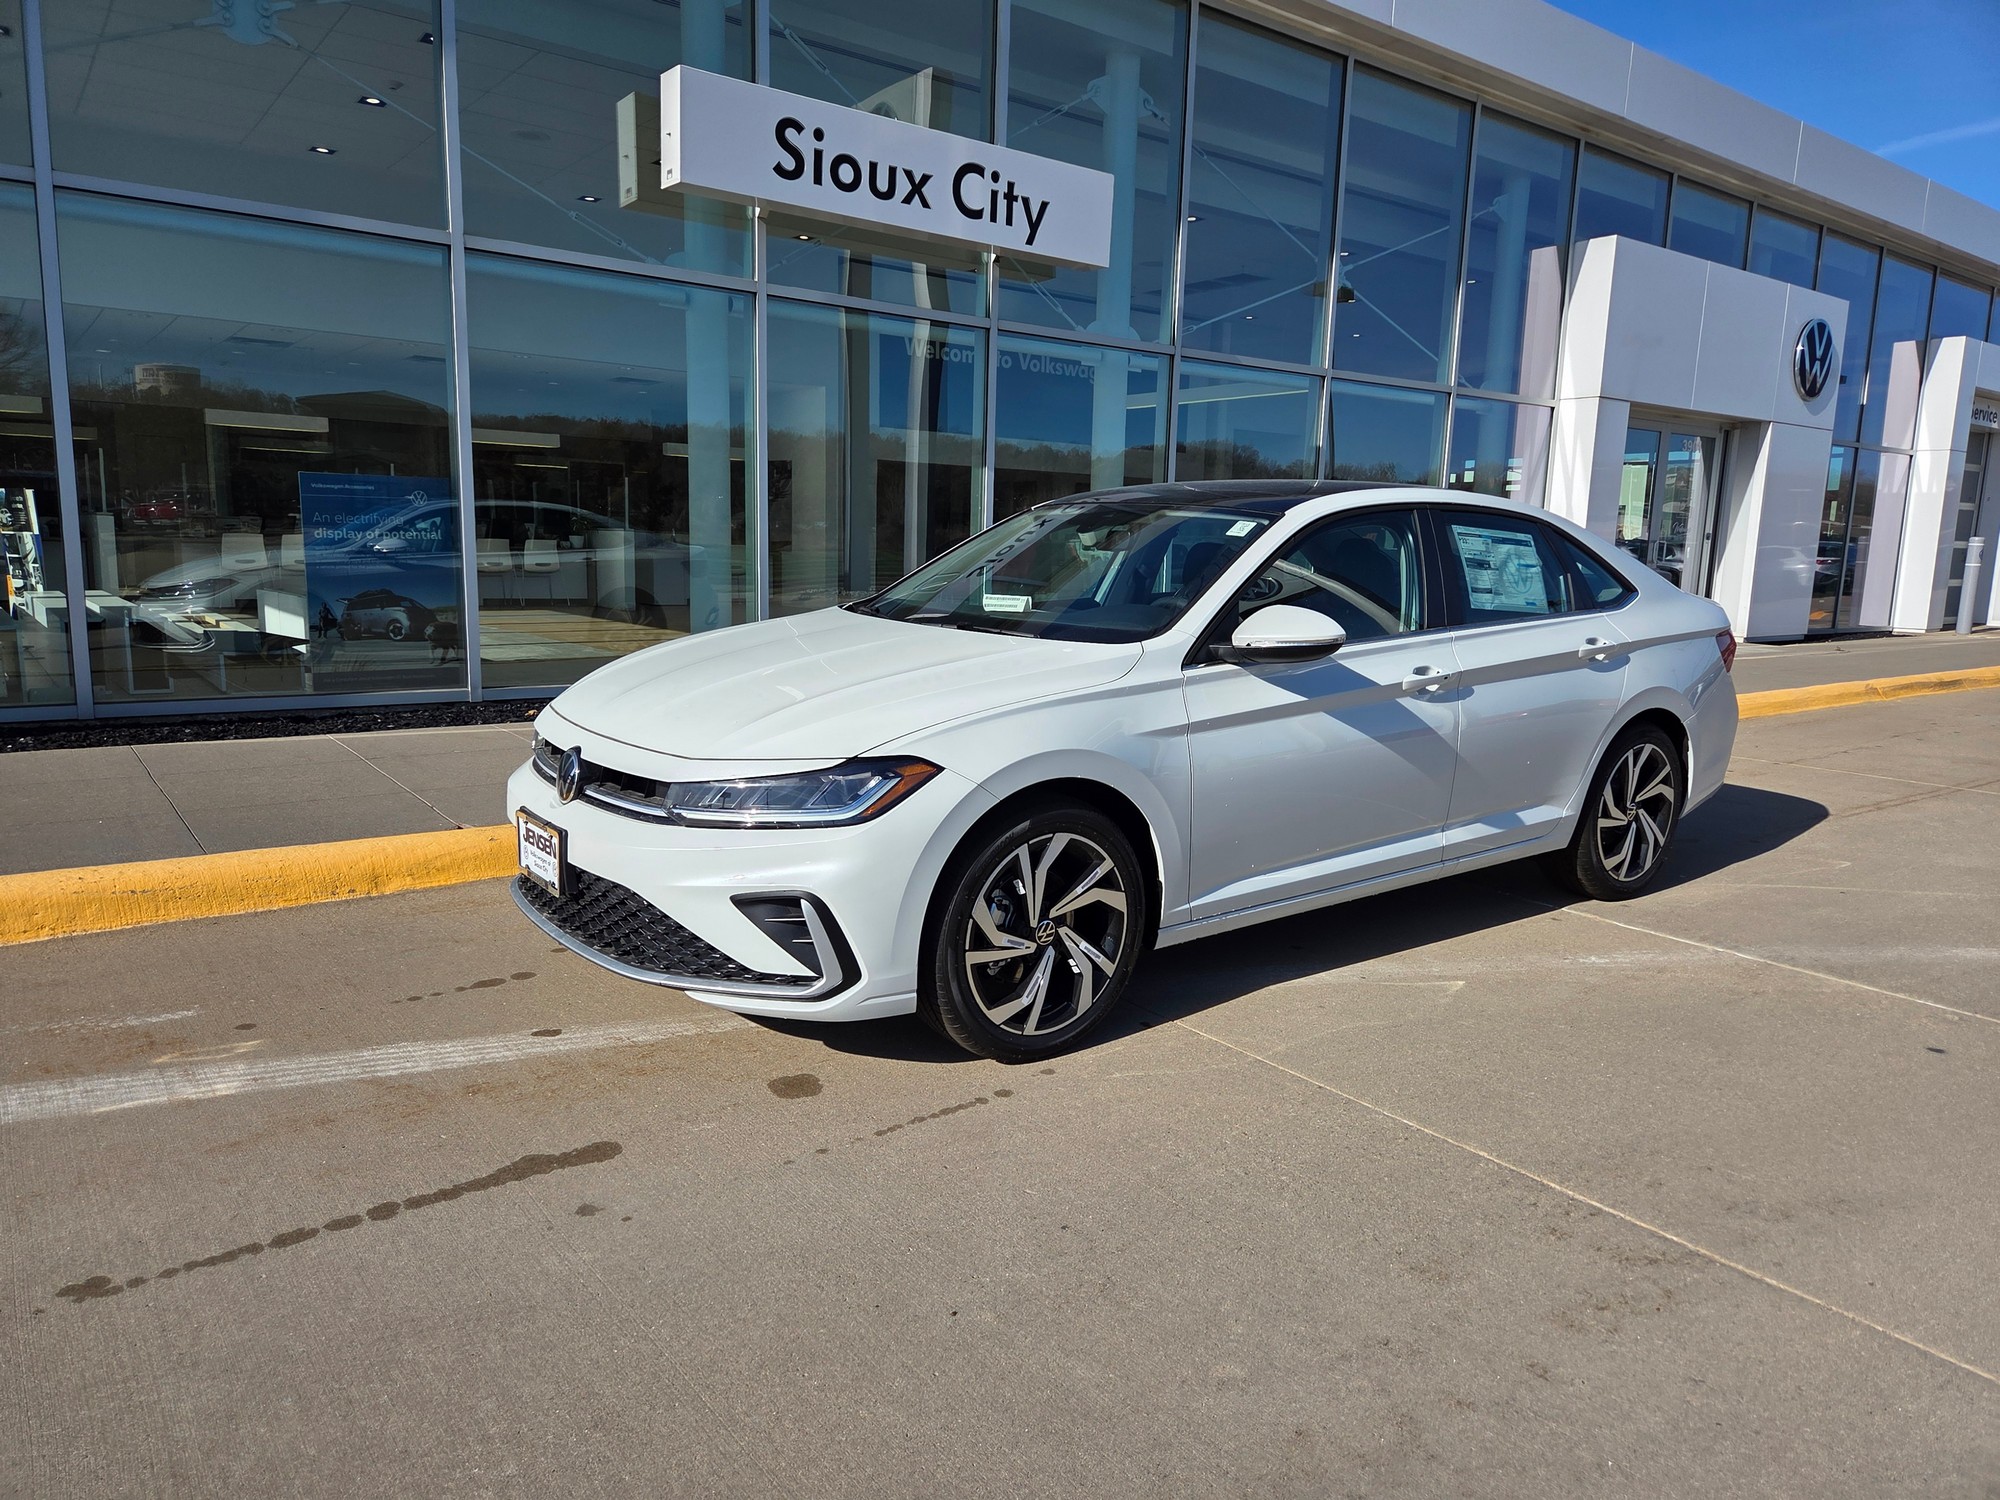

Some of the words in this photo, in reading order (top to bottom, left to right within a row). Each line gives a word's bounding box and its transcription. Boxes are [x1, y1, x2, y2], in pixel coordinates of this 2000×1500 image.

[772, 116, 934, 210] Sioux
[952, 161, 1051, 247] City
[904, 337, 975, 364] Welcom
[1018, 352, 1095, 384] Volkswag
[313, 512, 331, 523] An
[335, 511, 404, 527] electrifying
[314, 528, 362, 541] display
[365, 528, 380, 540] of
[382, 529, 443, 541] potential
[523, 826, 557, 859] JENSEN
